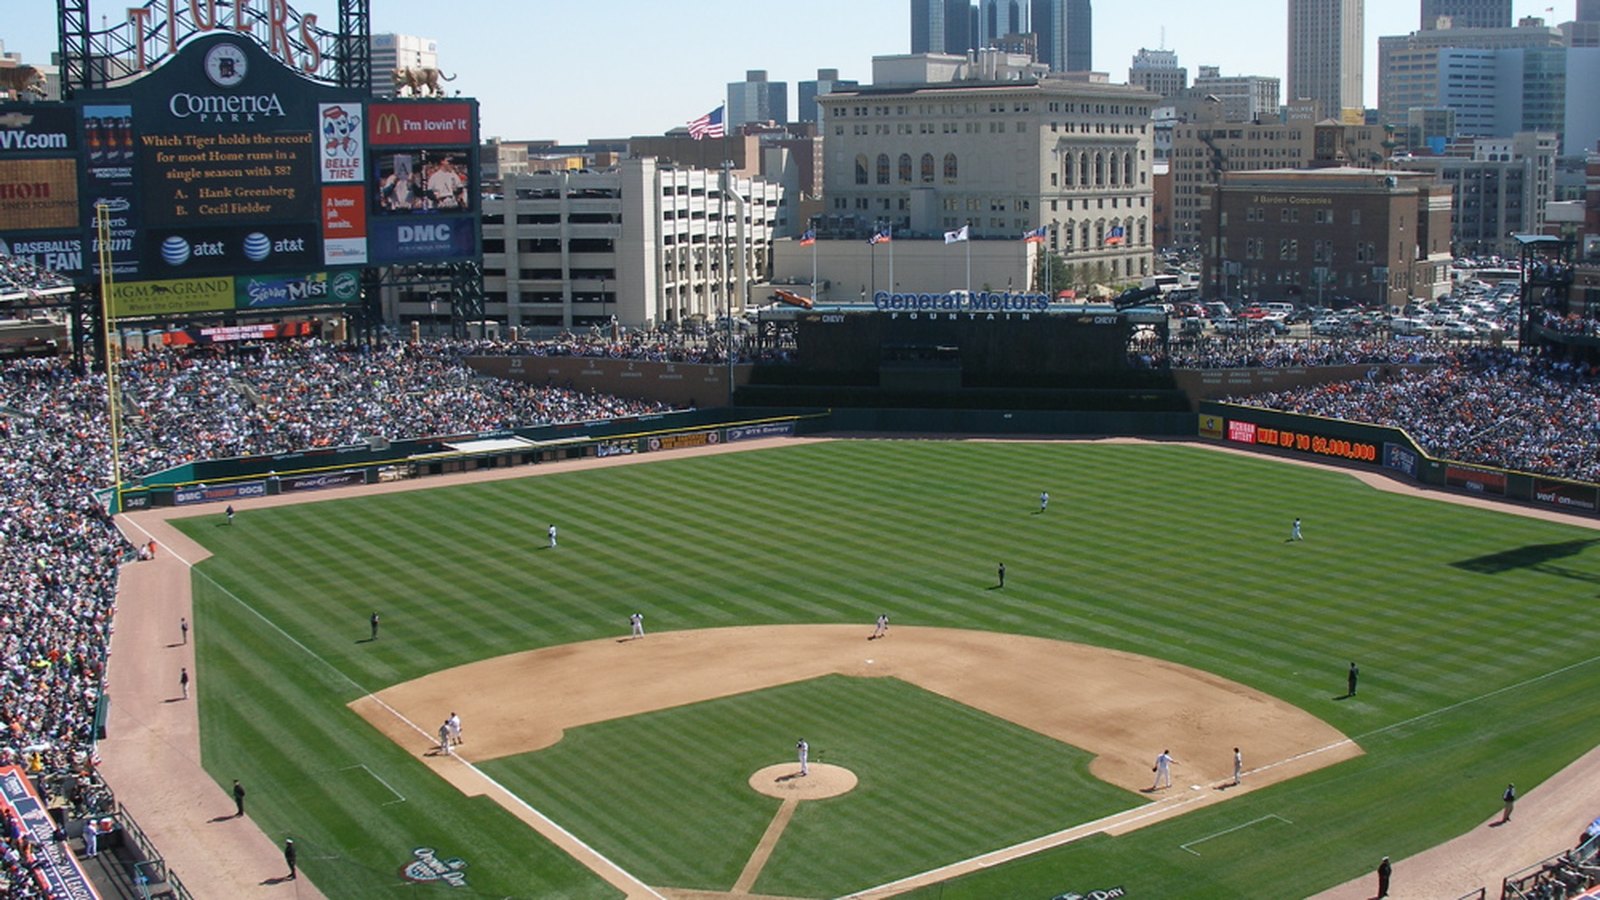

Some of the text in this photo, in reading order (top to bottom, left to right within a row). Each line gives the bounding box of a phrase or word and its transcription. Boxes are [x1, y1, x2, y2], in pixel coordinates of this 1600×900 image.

[200, 114, 255, 123] PARK
[403, 119, 467, 131] i'm lovin' it
[142, 132, 313, 149] Which Tiger holds the record
[156, 150, 296, 163] for most Home runs in a
[325, 158, 360, 169] BELLE
[166, 165, 292, 183] single season with 58?
[329, 169, 355, 179] TIRE
[174, 185, 295, 199] A. Hank Greenberg
[176, 202, 272, 215] B. Cecil Fielder
[326, 197, 333, 207] A
[398, 224, 450, 242] DMC
[14, 241, 81, 254] BASEBALL'S
[193, 241, 224, 256] at&t
[274, 238, 304, 252] at&t
[45, 252, 82, 272] FAN
[173, 280, 228, 294] GRAND
[249, 288, 287, 306] Sierra
[286, 280, 328, 300] Mist
[874, 289, 1049, 311] General Motors
[1094, 316, 1118, 324] CHEVY
[763, 425, 790, 434] Energy
[1257, 428, 1376, 461] WIN UP TO $2,000,000
[239, 485, 264, 496] DOCS
